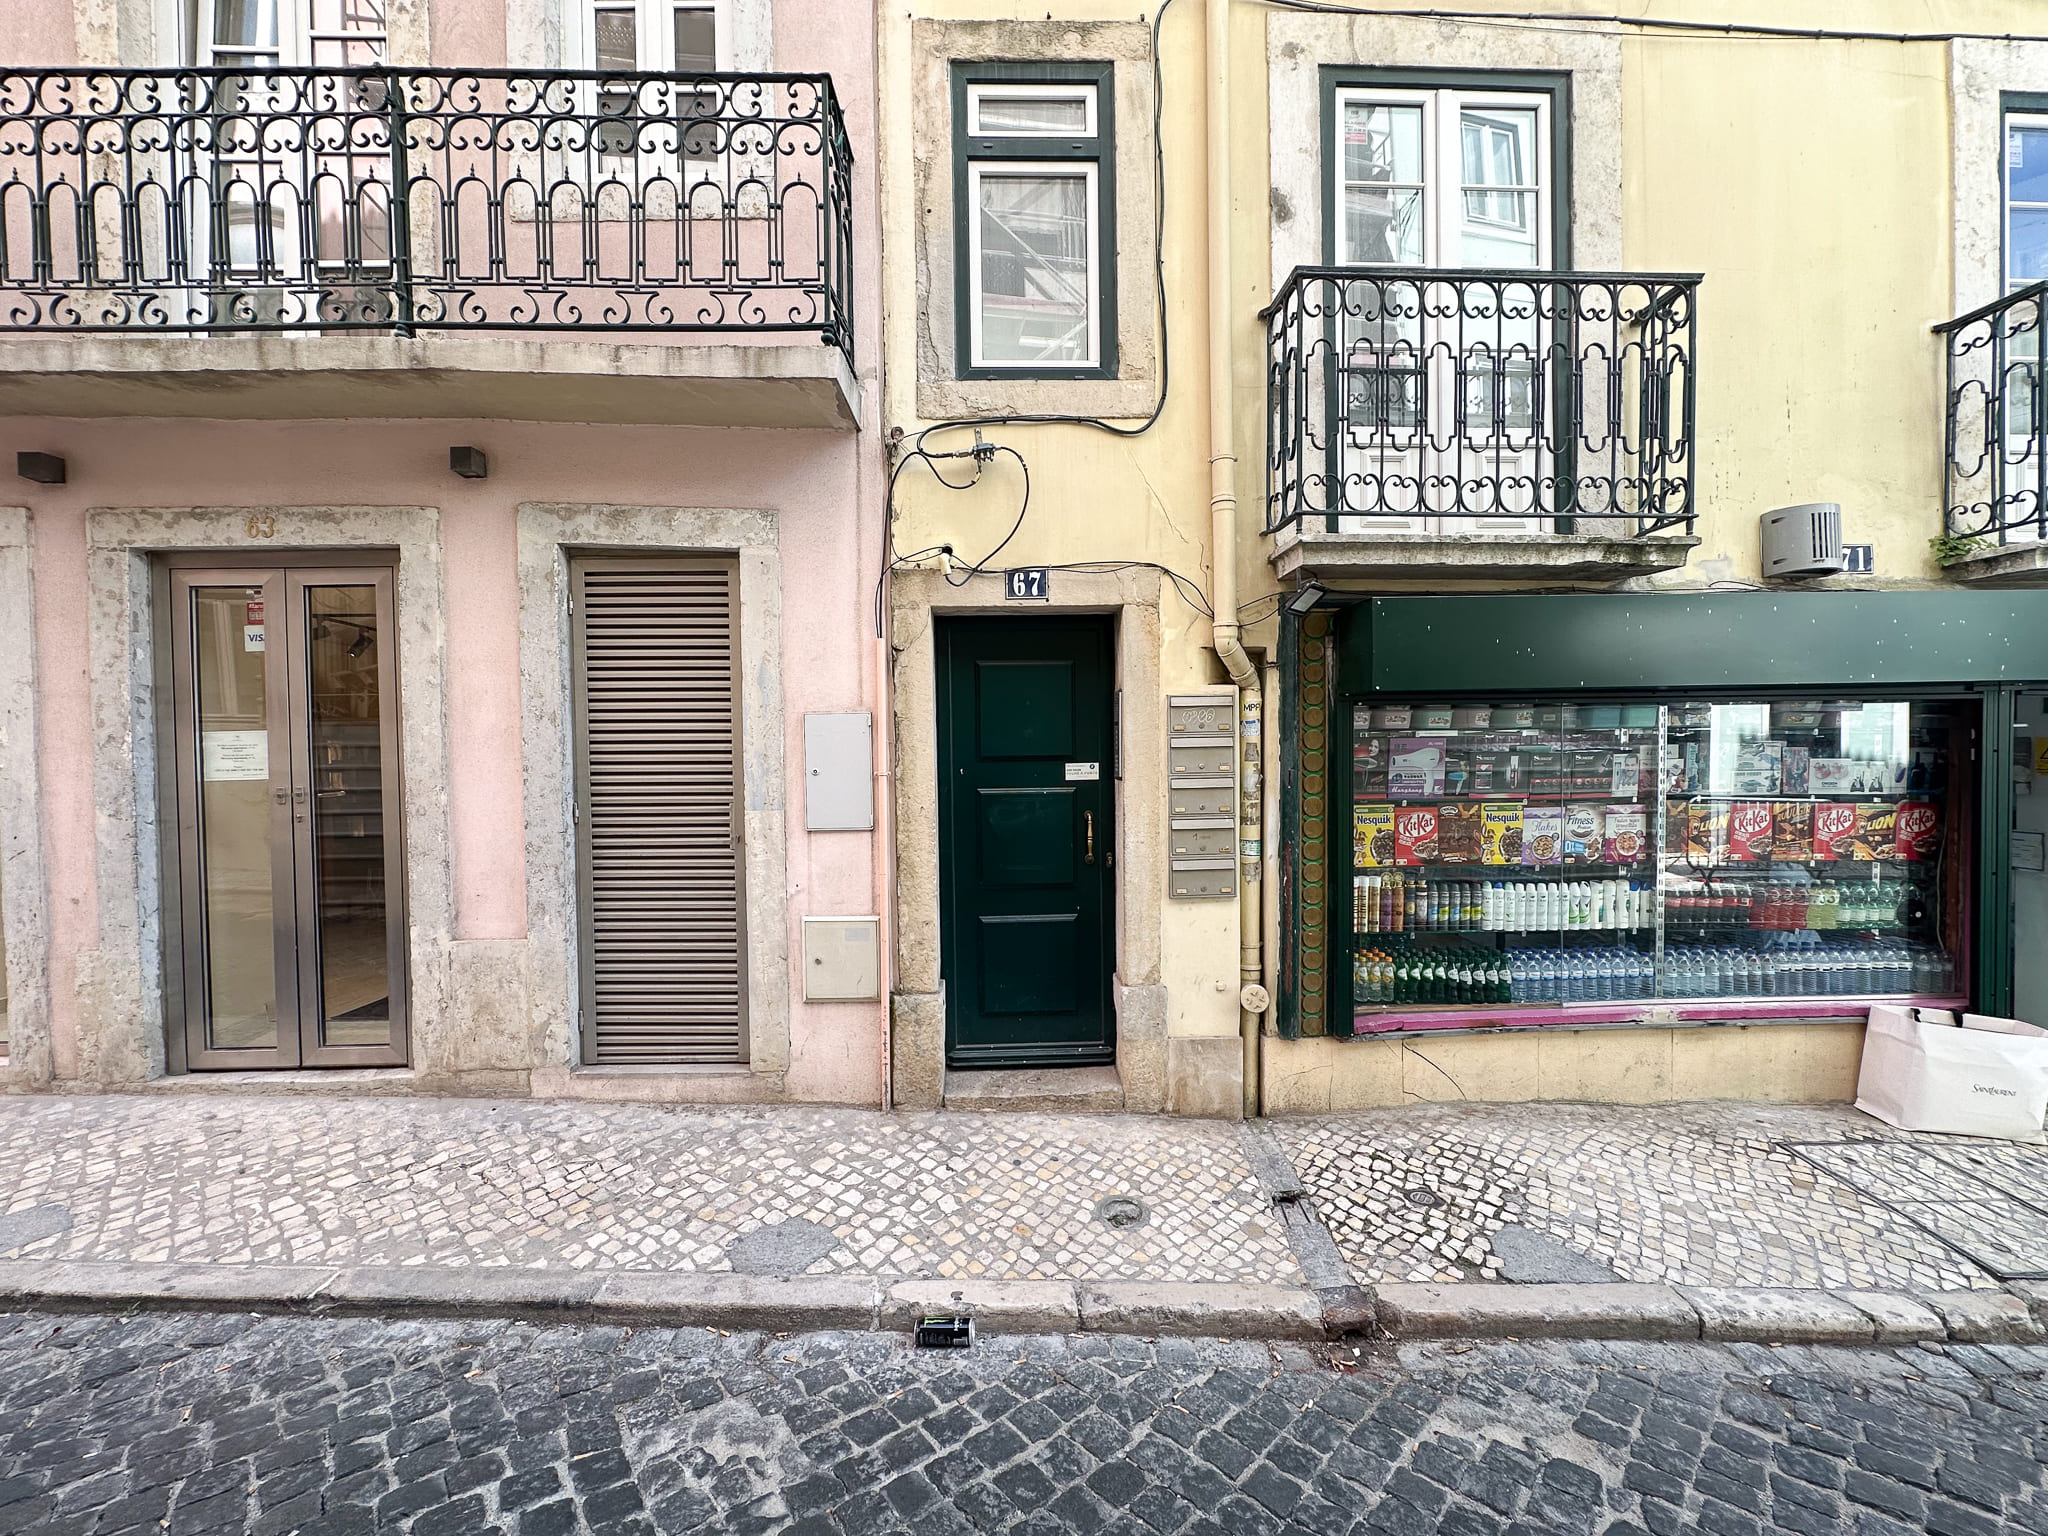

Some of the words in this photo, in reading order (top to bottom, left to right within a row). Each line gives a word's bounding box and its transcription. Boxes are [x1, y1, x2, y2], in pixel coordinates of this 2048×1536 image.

[246, 515, 275, 538] 63
[1842, 547, 1866, 571] 71
[1013, 571, 1041, 596] 67
[248, 634, 264, 642] VIS
[1356, 814, 1391, 826] Nesquik
[1402, 813, 1433, 836] KitKat
[1486, 812, 1520, 824] Nesquik
[1566, 814, 1595, 825] Fitness
[1700, 813, 1730, 831] LION
[1738, 809, 1768, 832] KitKat
[1822, 809, 1852, 832] KitKat
[1867, 813, 1898, 831] LION
[1904, 809, 1936, 832] KitKat
